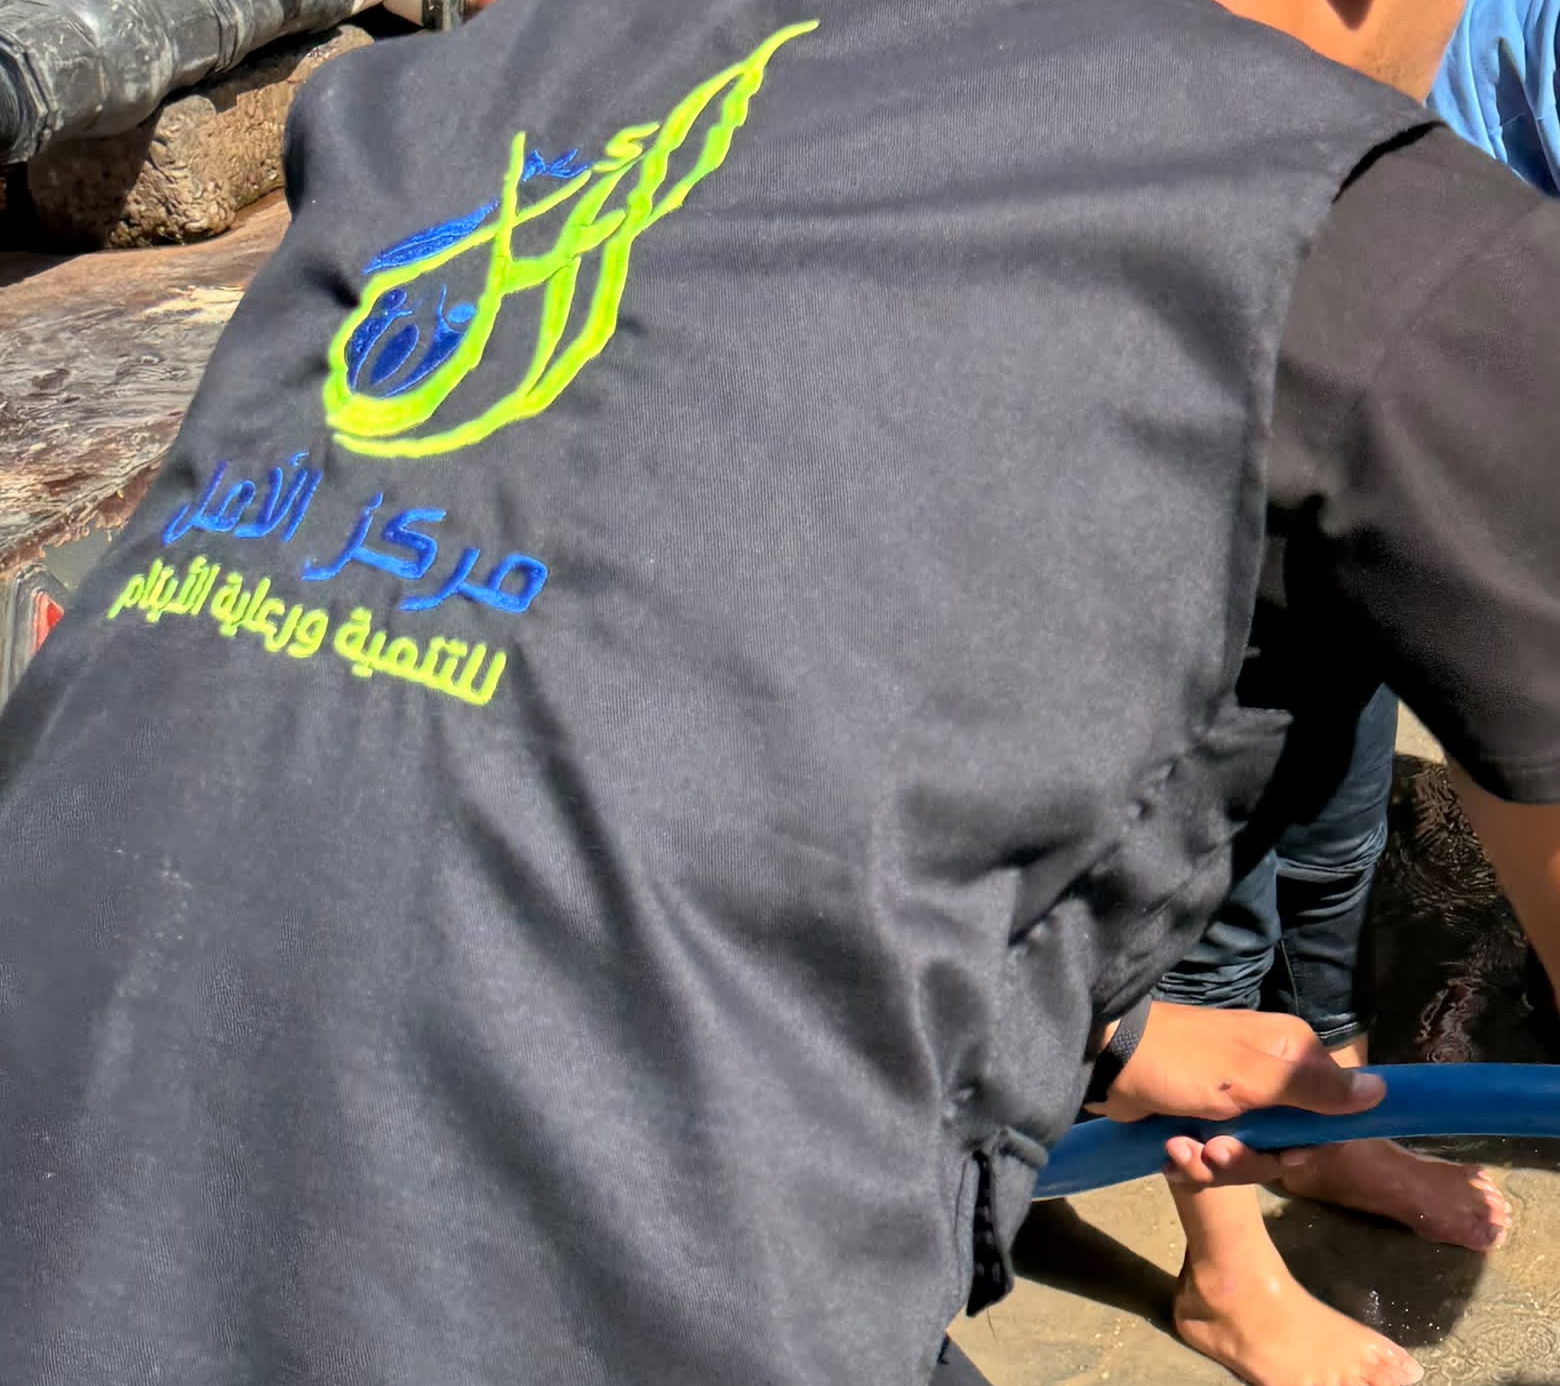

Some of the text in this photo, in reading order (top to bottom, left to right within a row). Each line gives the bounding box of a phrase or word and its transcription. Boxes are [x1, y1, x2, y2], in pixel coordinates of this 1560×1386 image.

[161, 451, 548, 614] مركز الأمل
[211, 571, 330, 658] ورعاية
[335, 607, 507, 707] للتنمية
